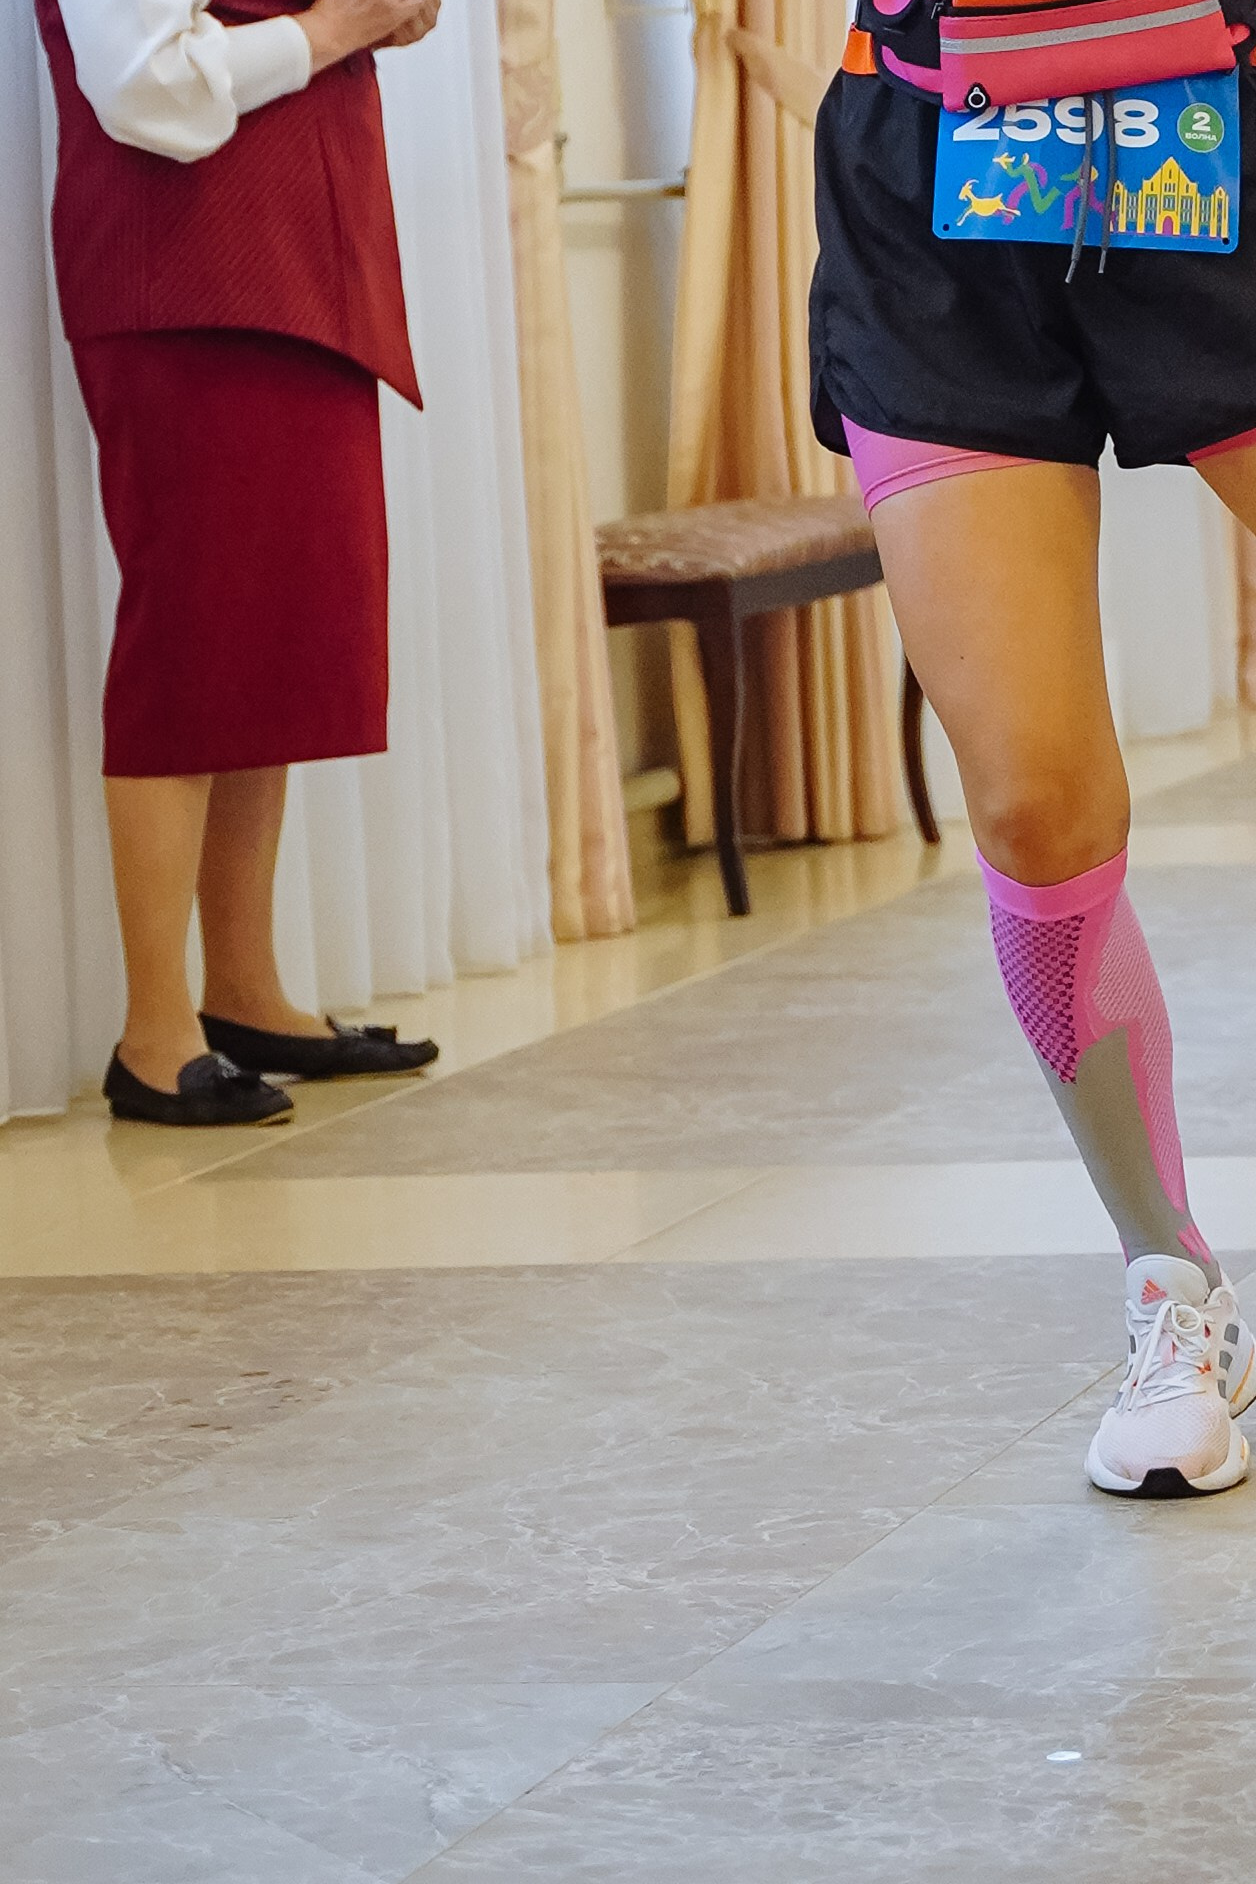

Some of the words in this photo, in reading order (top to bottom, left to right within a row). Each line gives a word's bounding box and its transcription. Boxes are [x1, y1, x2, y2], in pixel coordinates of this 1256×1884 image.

[953, 96, 1160, 148] 2598
[1191, 111, 1211, 132] 2
[1185, 132, 1218, 142] ВОЛНА
